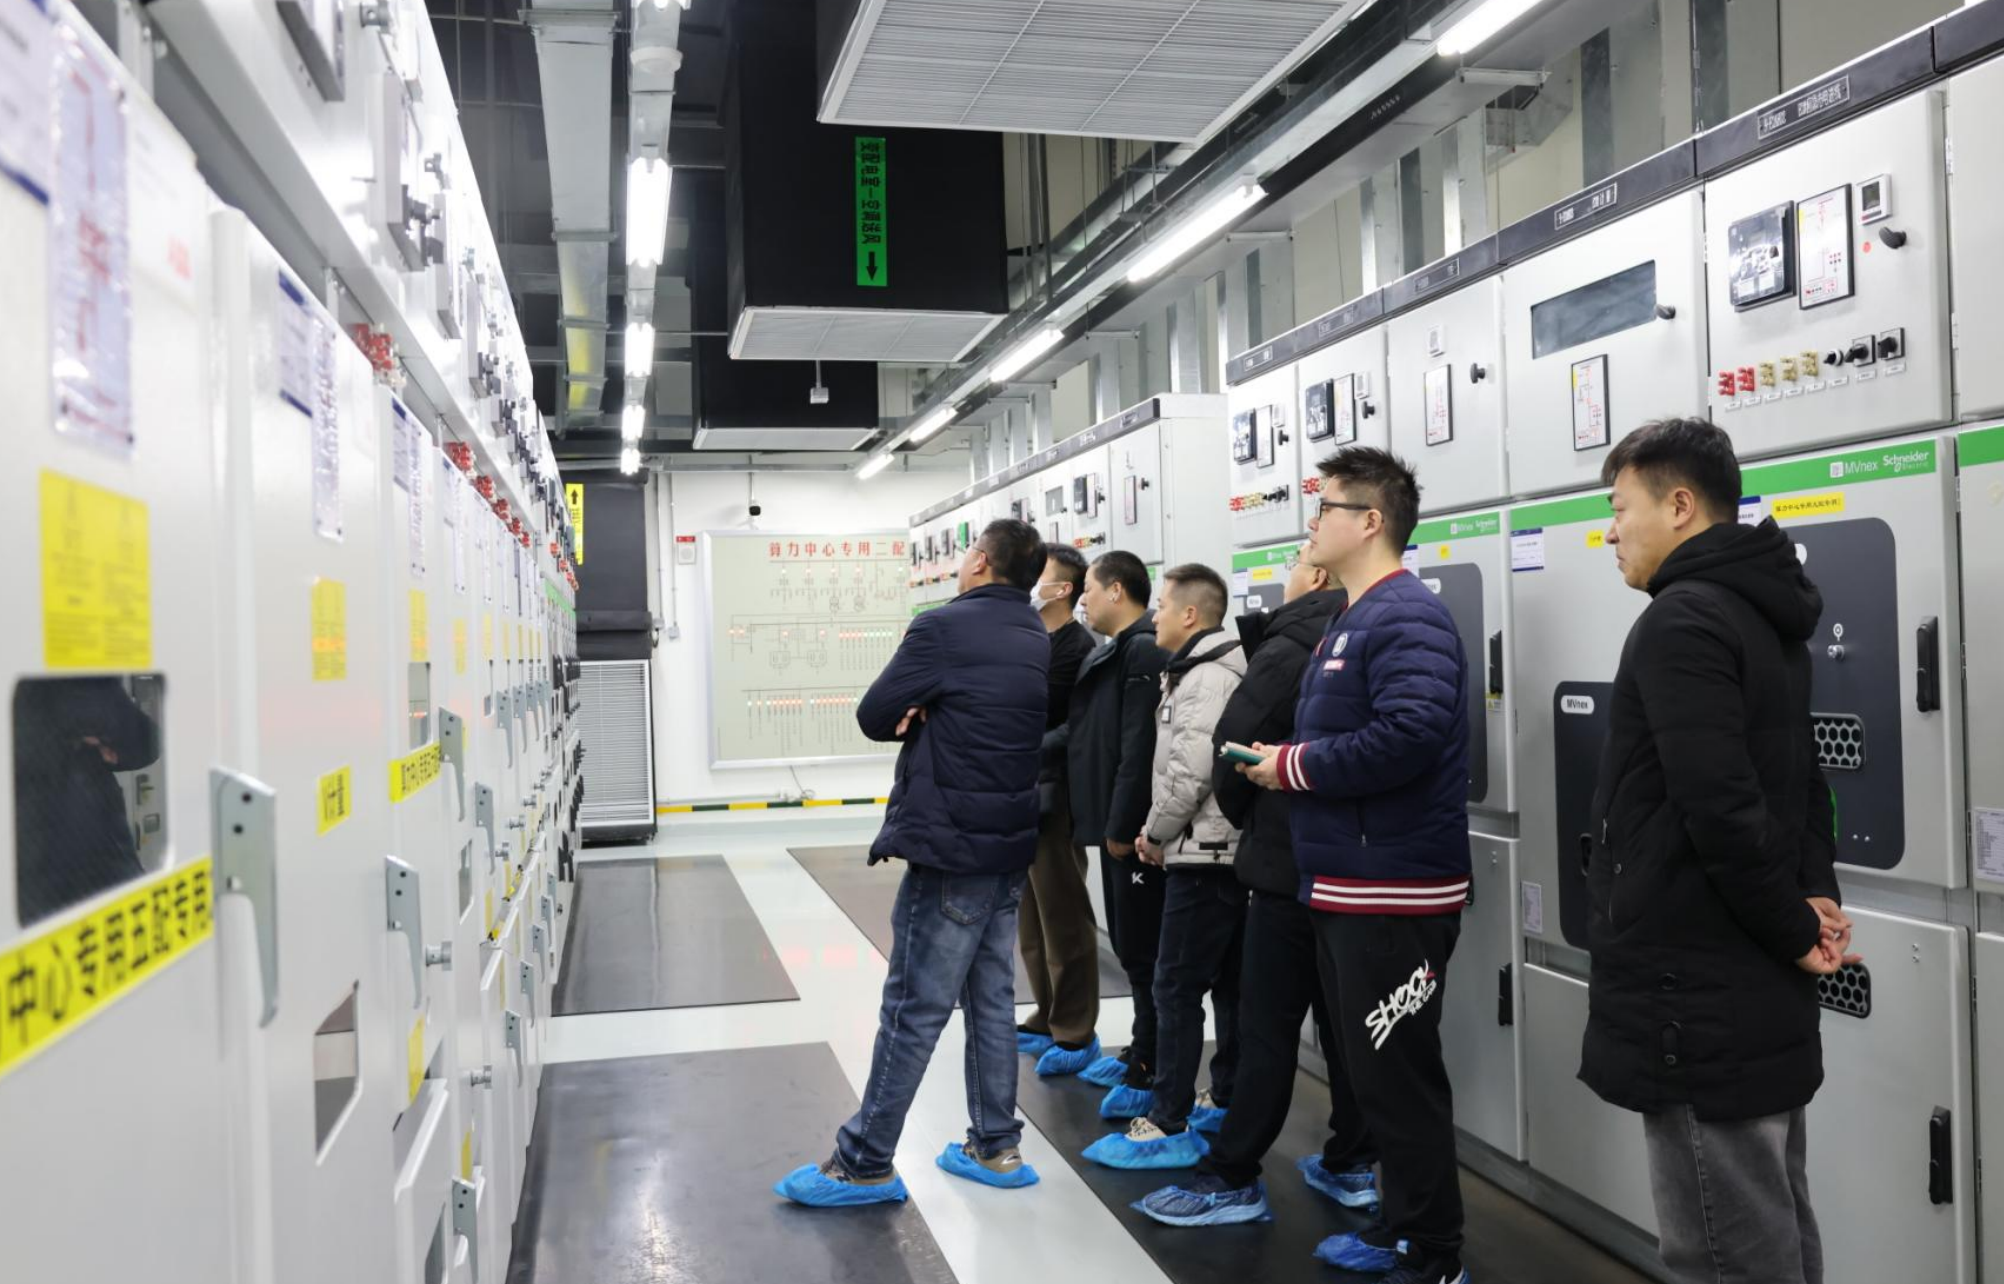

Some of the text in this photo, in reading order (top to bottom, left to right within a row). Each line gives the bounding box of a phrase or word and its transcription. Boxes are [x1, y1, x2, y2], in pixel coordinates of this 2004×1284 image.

[1844, 450, 1930, 474] MVnex Schneider
[769, 541, 906, 558] 算力中心专用二配
[1566, 698, 1588, 710] MVnex
